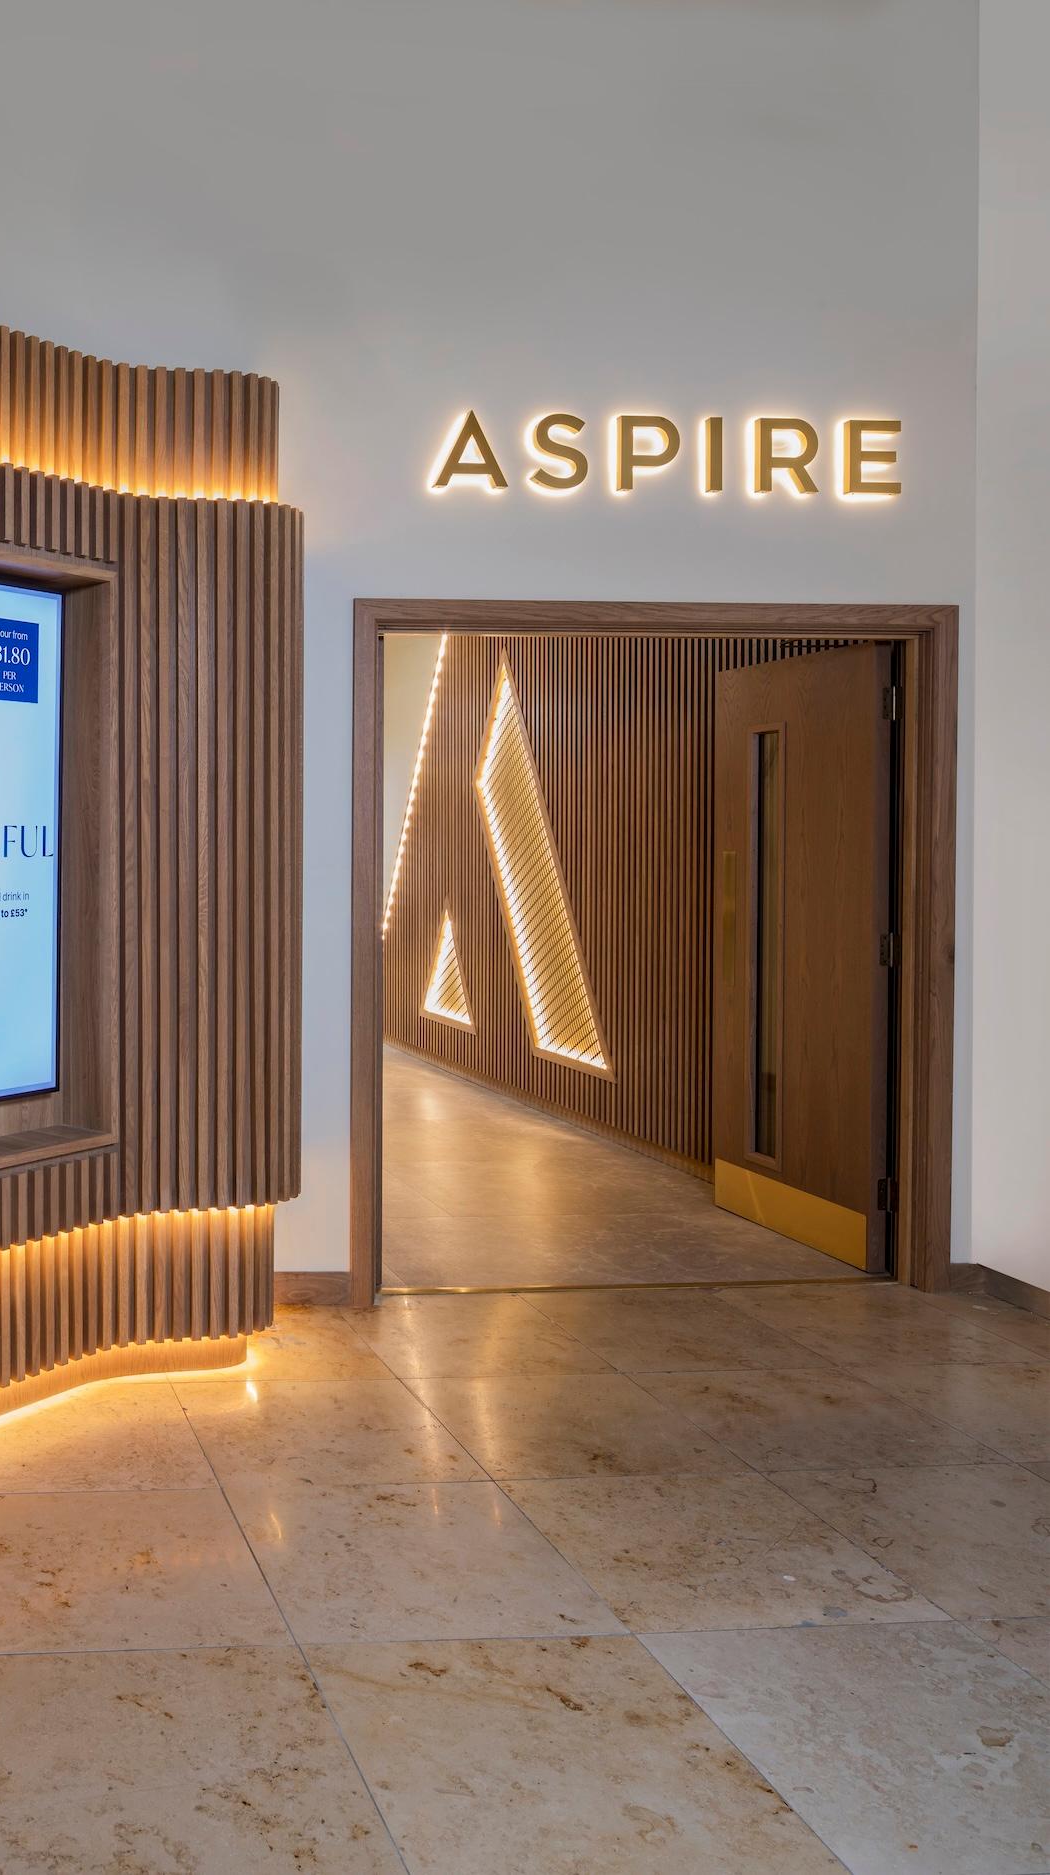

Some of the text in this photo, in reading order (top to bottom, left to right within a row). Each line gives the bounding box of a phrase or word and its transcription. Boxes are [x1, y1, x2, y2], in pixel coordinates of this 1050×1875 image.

[431, 409, 902, 496] ASPIRE
[12, 630, 28, 640] from
[3, 670, 16, 680] PER
[2, 891, 21, 902] drink
[23, 891, 30, 901] in
[1, 910, 9, 918] to
